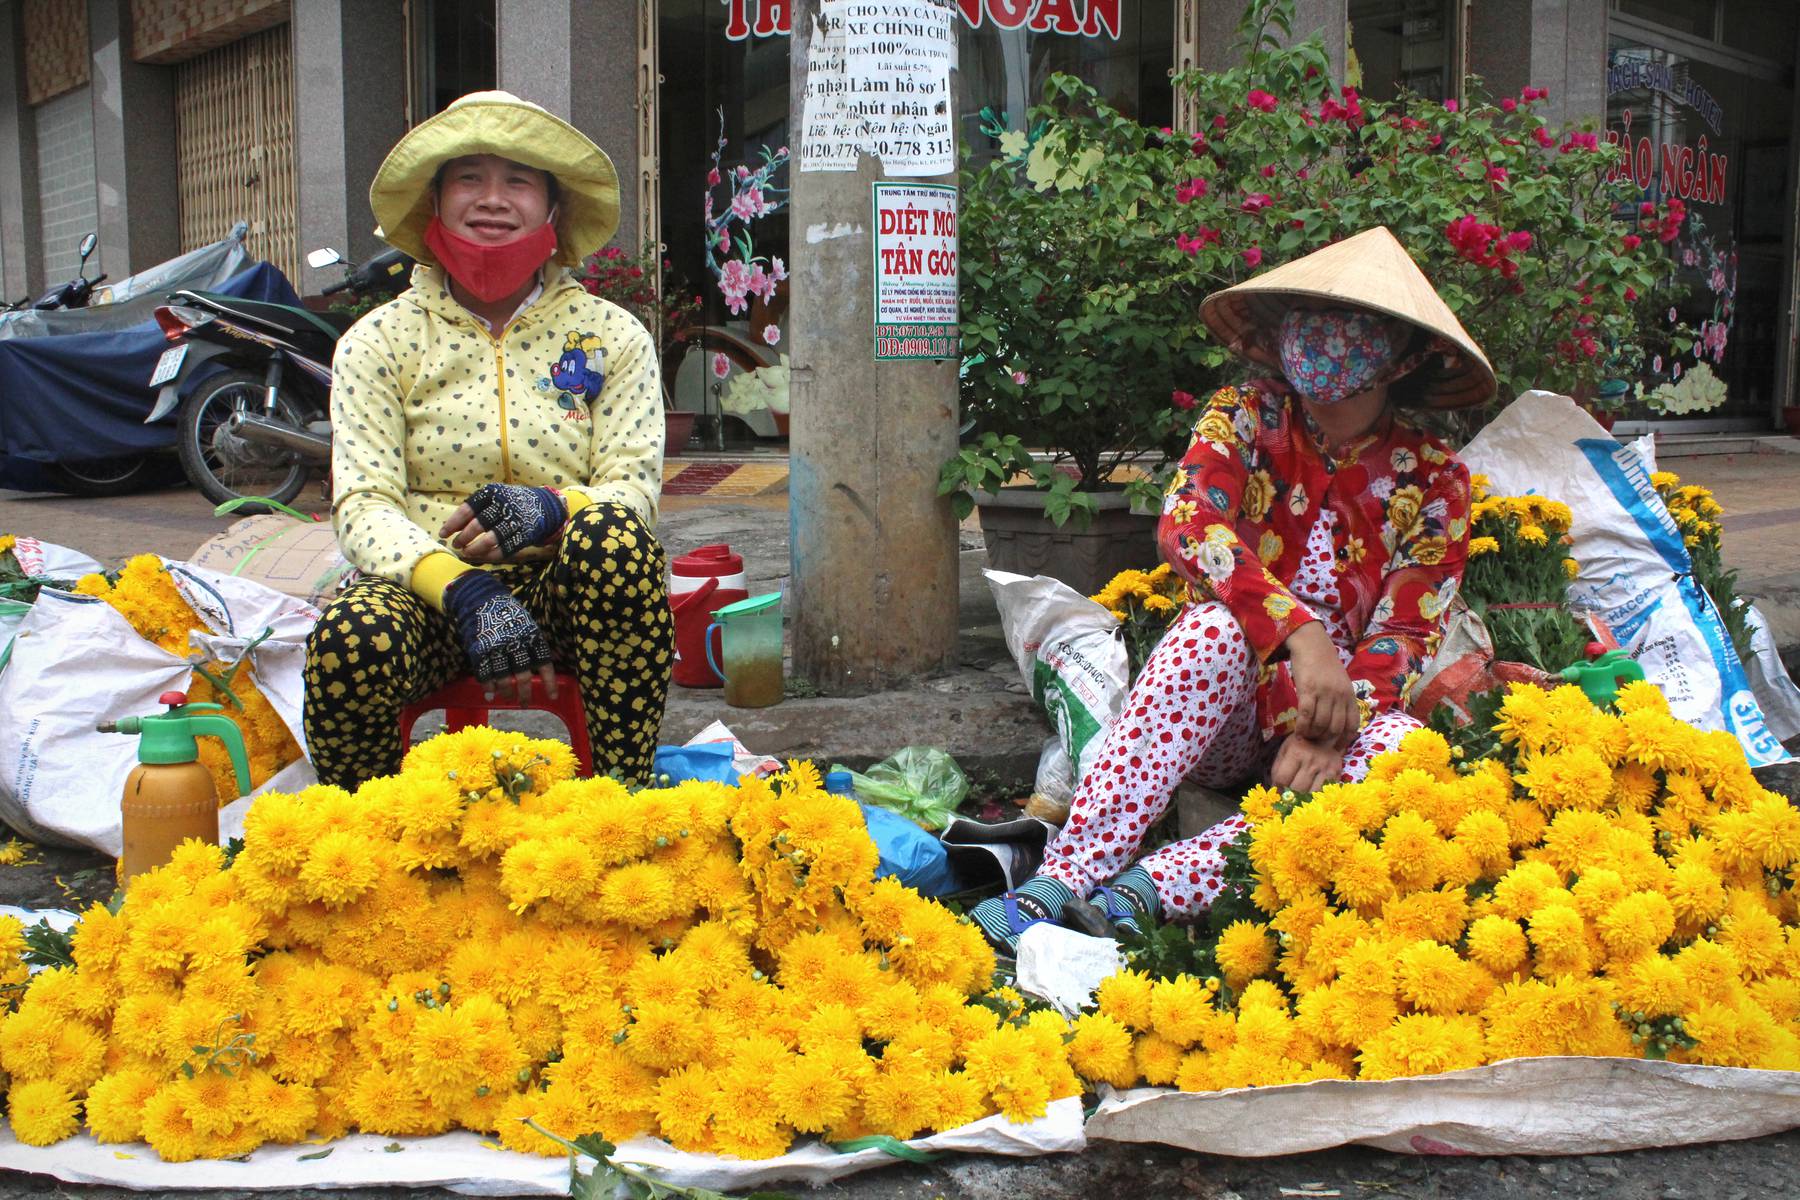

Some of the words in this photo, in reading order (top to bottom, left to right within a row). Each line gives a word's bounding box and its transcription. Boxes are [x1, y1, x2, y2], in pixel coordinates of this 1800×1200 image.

[847, 5, 878, 17] CHO
[882, 5, 911, 17] VAY
[848, 22, 869, 36] XE
[873, 19, 923, 37] CHÍNH
[870, 42, 911, 56] 100%
[850, 77, 889, 93] Làm
[896, 74, 915, 93] hồ
[919, 82, 937, 95] sơ
[891, 101, 928, 119] nhận
[832, 123, 851, 139] hệ:
[890, 121, 909, 137] hệ:
[926, 138, 951, 156] 313
[1660, 134, 1728, 206] NGÂN
[880, 202, 929, 242] DIỆT
[881, 242, 924, 281] TẬN
[928, 239, 956, 276] GỐC
[562, 410, 590, 421] Mic
[1056, 641, 1074, 656] TCS
[1735, 702, 1779, 754] 3715
